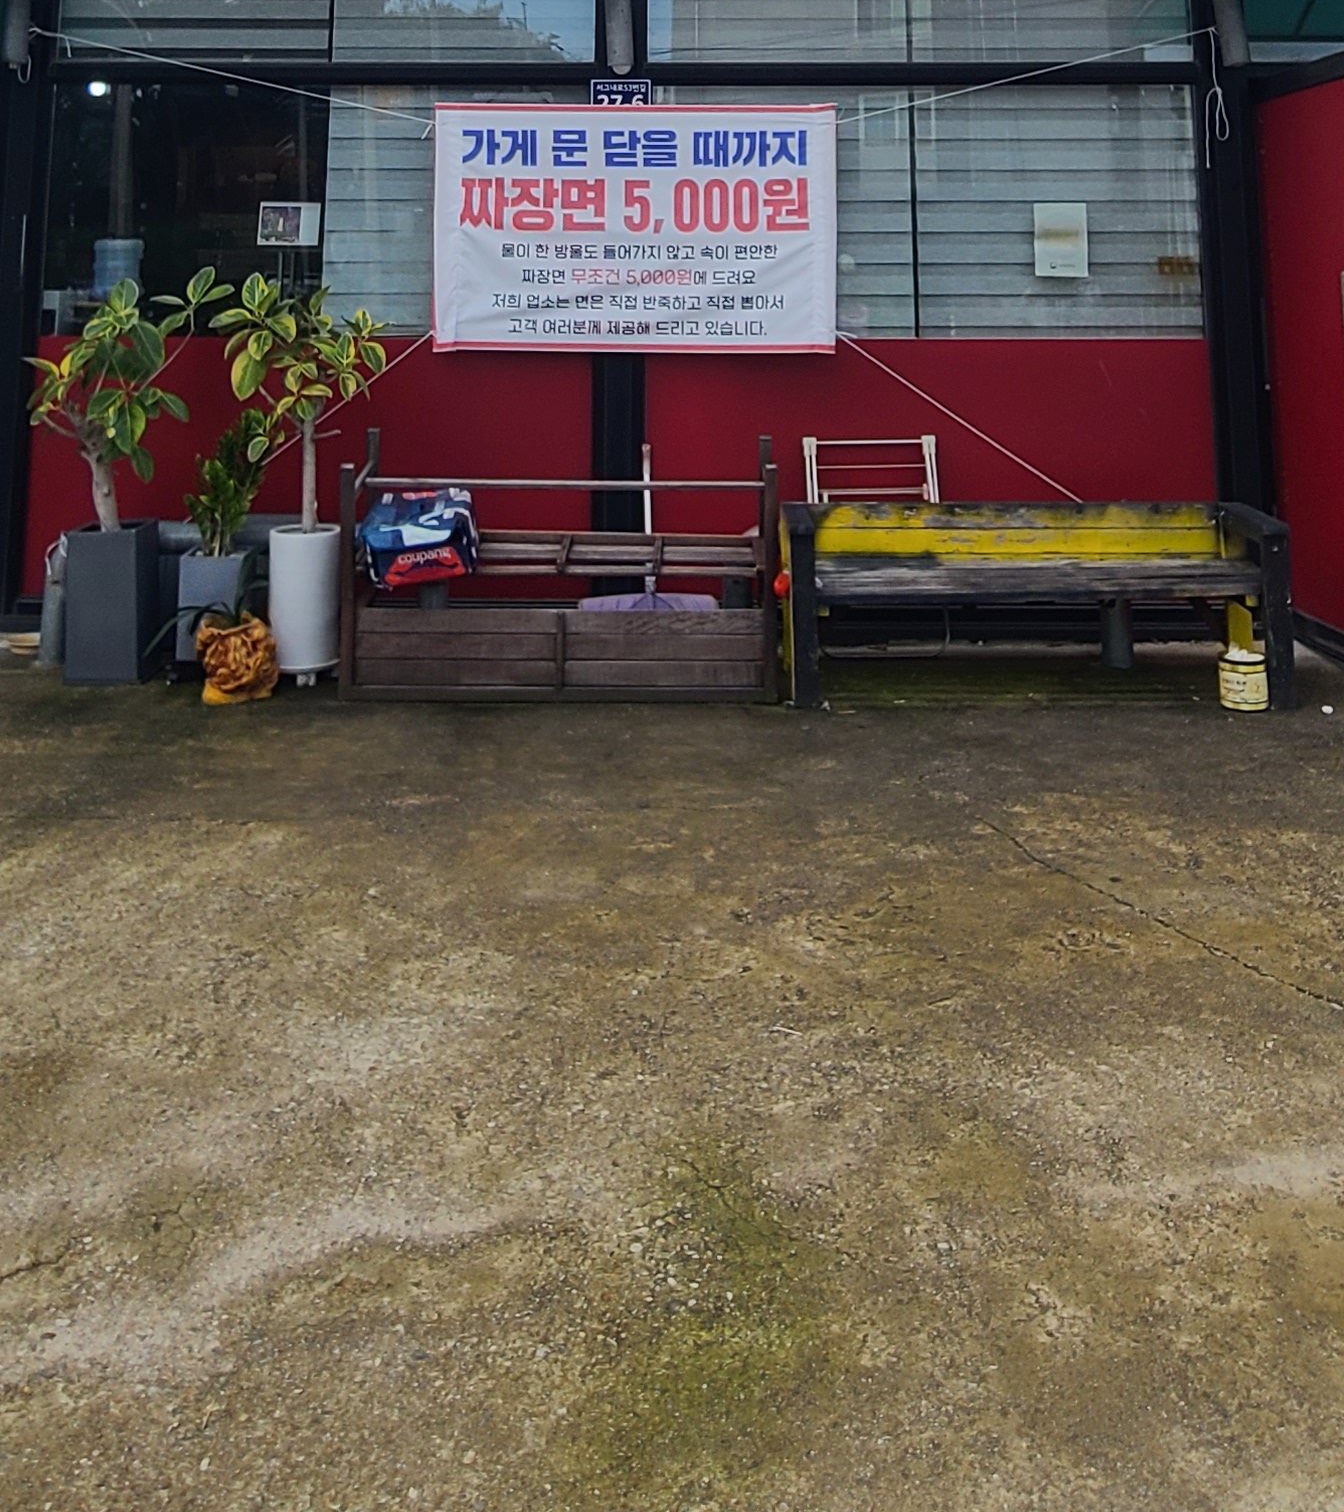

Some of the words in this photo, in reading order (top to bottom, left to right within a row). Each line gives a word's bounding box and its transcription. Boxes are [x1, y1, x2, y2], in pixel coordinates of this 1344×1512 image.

[461, 129, 538, 167] 가게
[551, 129, 588, 167] 문
[603, 129, 679, 168] 닫을
[693, 129, 808, 168] 때까지
[459, 177, 607, 232] 짜장면
[623, 177, 811, 234] 5,000원
[501, 243, 530, 258] 물이
[535, 243, 550, 259] 한
[554, 243, 598, 260] 방울도
[603, 244, 661, 260] 들어가지
[666, 244, 696, 260] 않고
[700, 244, 729, 260] 속이
[734, 244, 778, 260] 편안한
[522, 268, 566, 284] 짜장면
[571, 268, 620, 285] 무조건
[626, 268, 707, 286] 5,000원에
[711, 269, 756, 285] 드려요
[492, 293, 522, 309] 저희
[526, 294, 570, 309] 업소는
[575, 294, 604, 310] 면은
[609, 295, 638, 310] 직접
[643, 295, 702, 311] 반죽하고
[706, 295, 735, 310] 직접
[508, 318, 538, 334] 고객
[542, 319, 602, 335] 여러분께
[607, 320, 650, 336] 제공해
[655, 320, 700, 336] 드리고
[705, 320, 768, 336] 있습니다.
[397, 548, 452, 565] coupang
